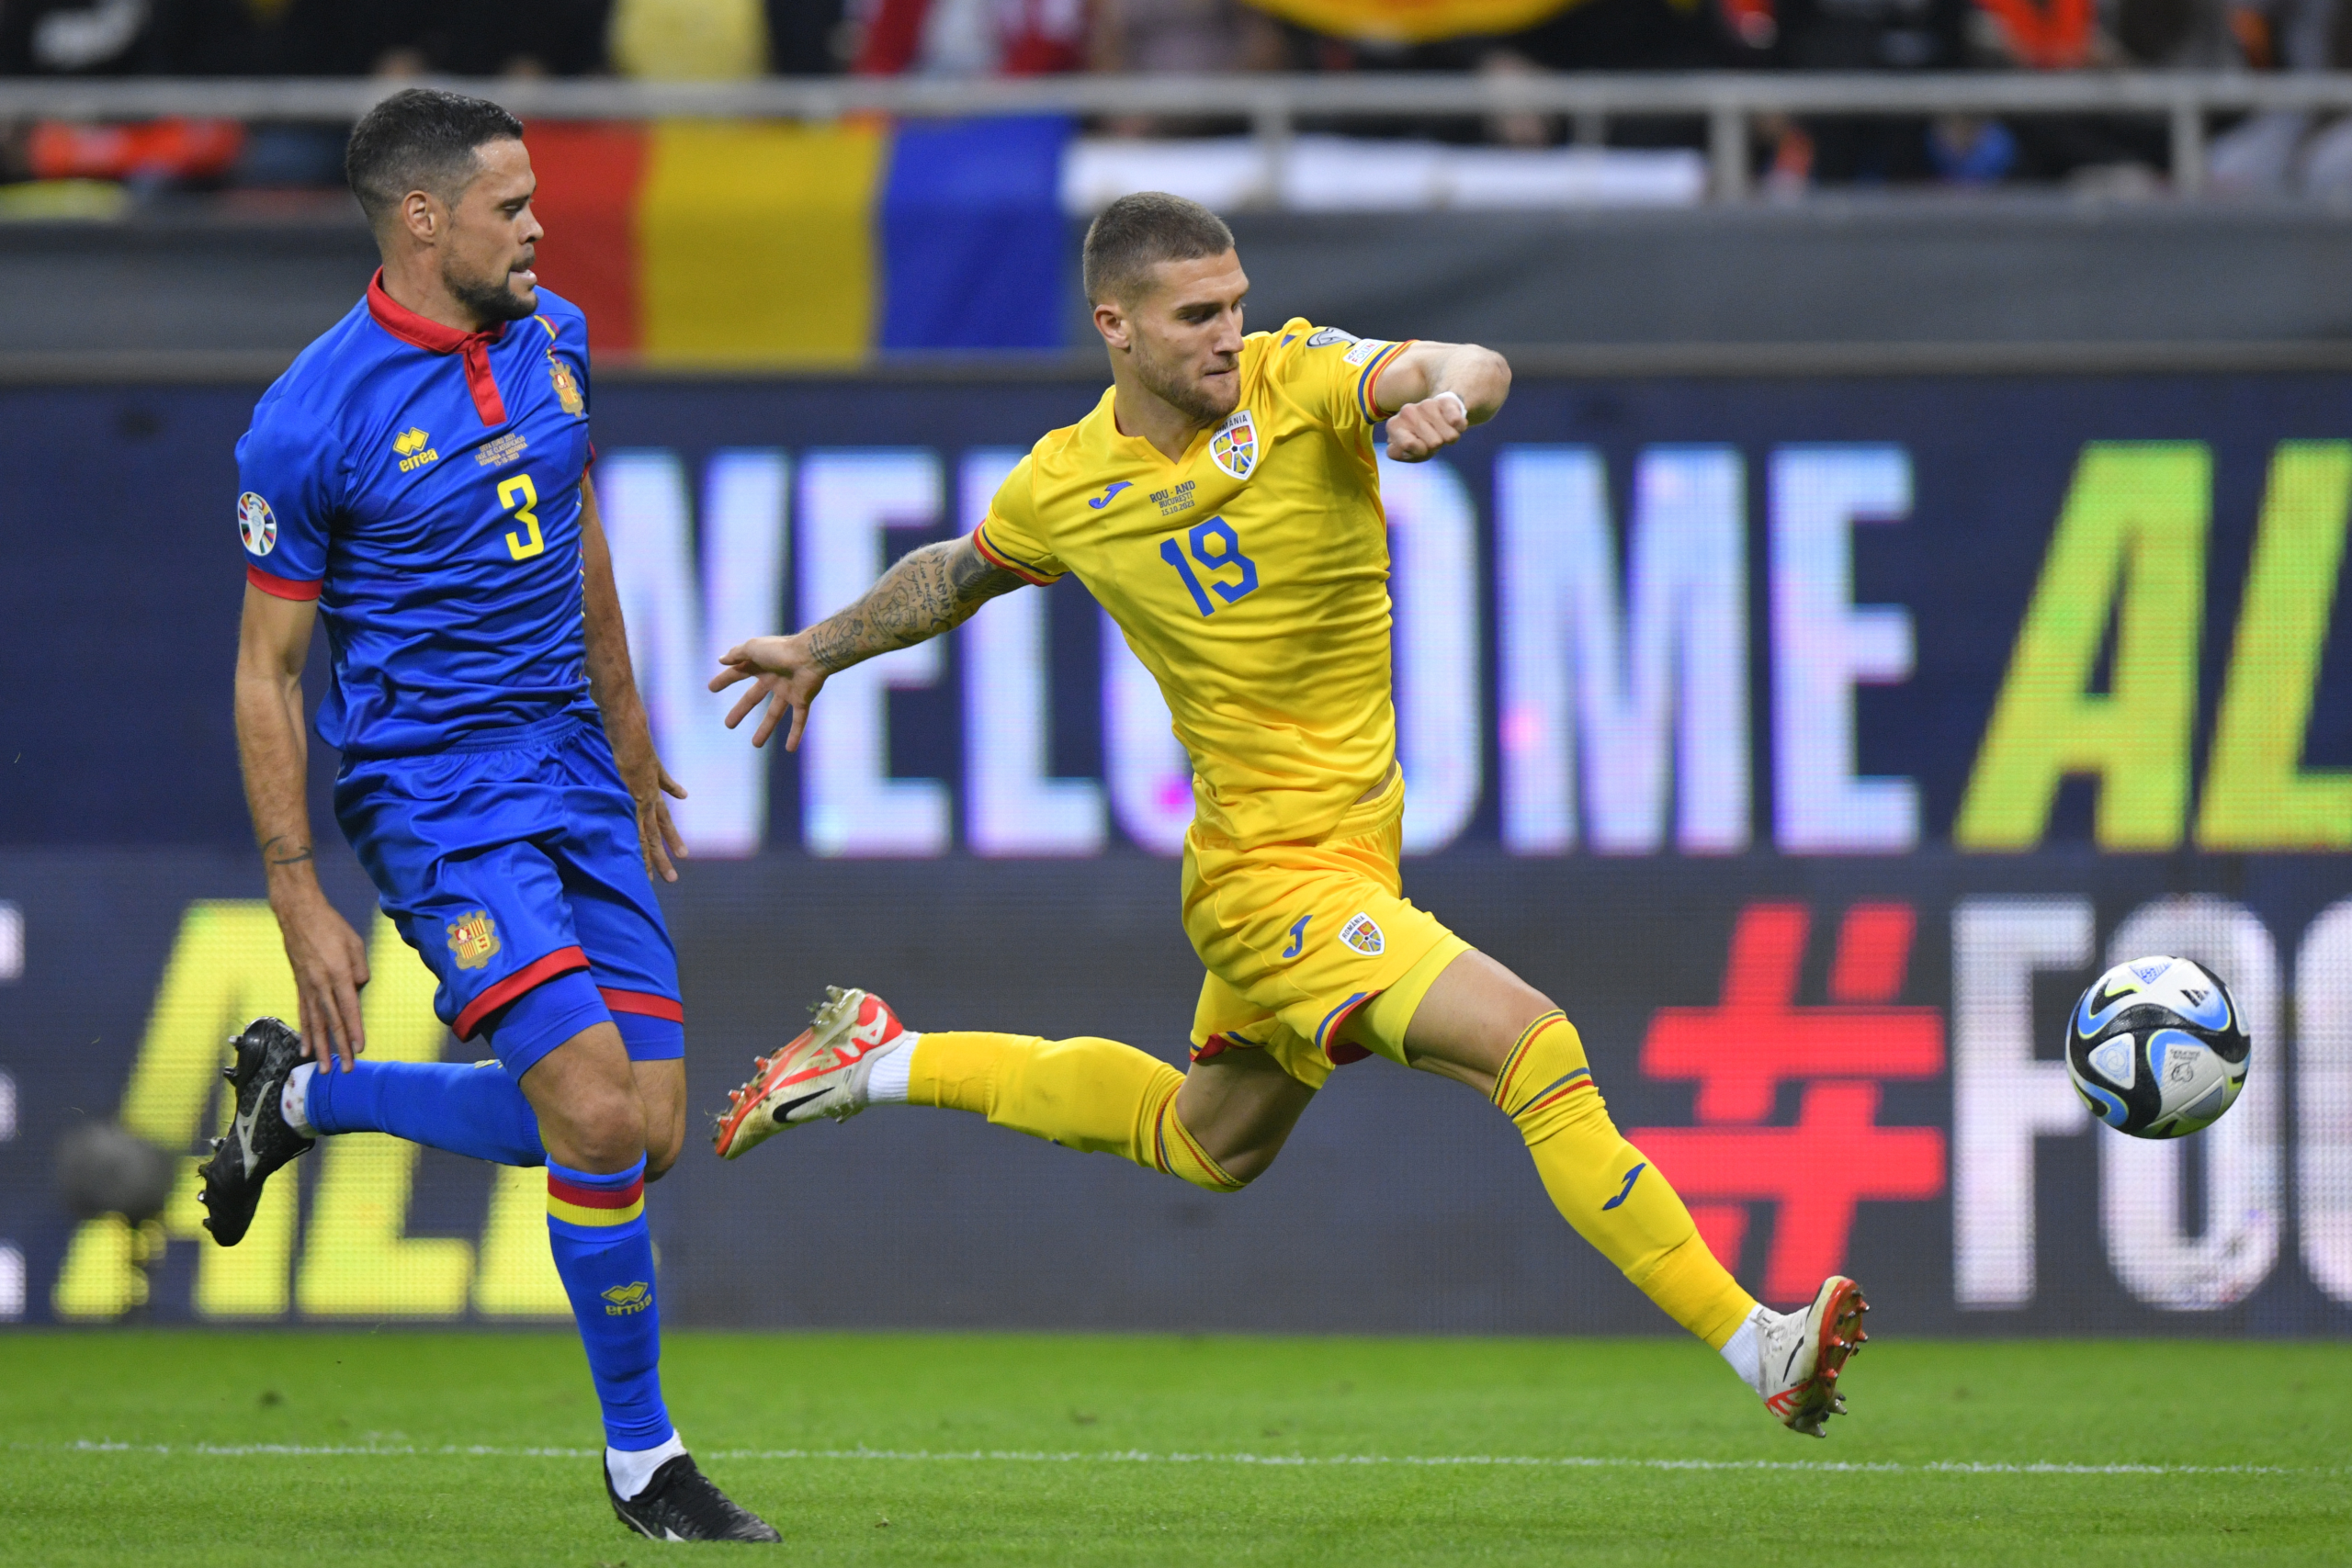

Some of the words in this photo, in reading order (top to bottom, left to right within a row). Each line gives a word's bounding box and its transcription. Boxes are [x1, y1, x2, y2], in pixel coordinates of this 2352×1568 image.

[497, 473, 545, 560] 3
[1149, 489, 1169, 503] ROU
[1174, 479, 1196, 494] AND
[1161, 500, 1195, 516] 15.10.2023
[1160, 515, 1259, 617] 19
